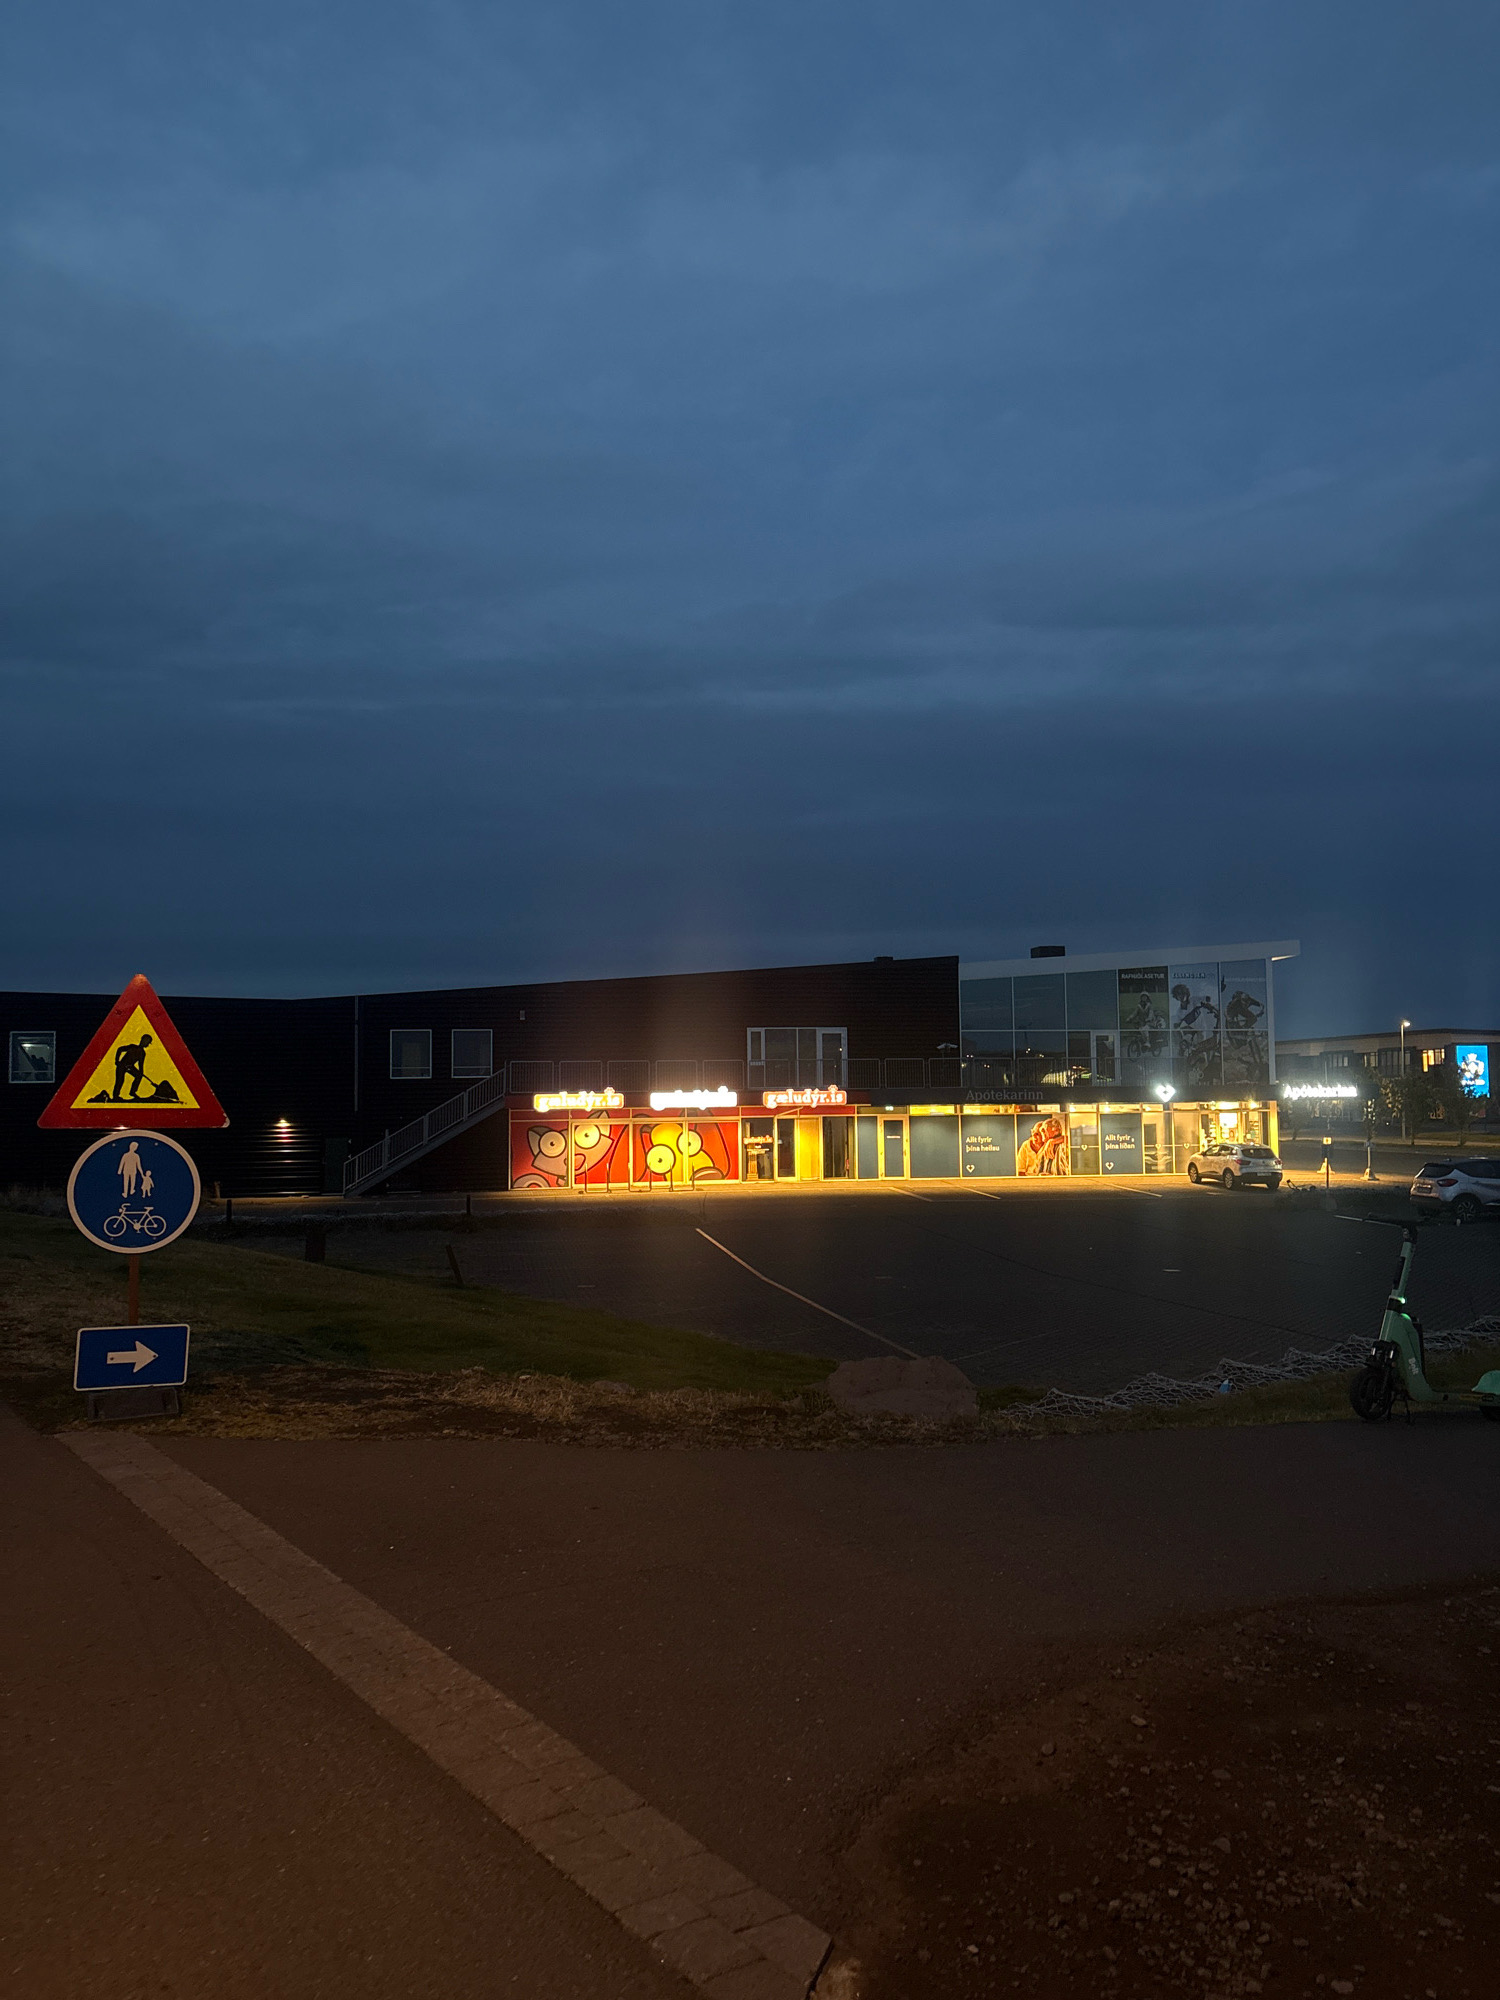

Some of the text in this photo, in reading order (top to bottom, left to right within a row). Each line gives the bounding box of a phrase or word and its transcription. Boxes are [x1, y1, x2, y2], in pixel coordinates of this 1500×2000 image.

[767, 1088, 843, 1108] gæludýr.is
[966, 1089, 1044, 1102] Apótekarinn
[978, 1136, 992, 1144] fyrir
[1117, 1134, 1131, 1142] fyrir
